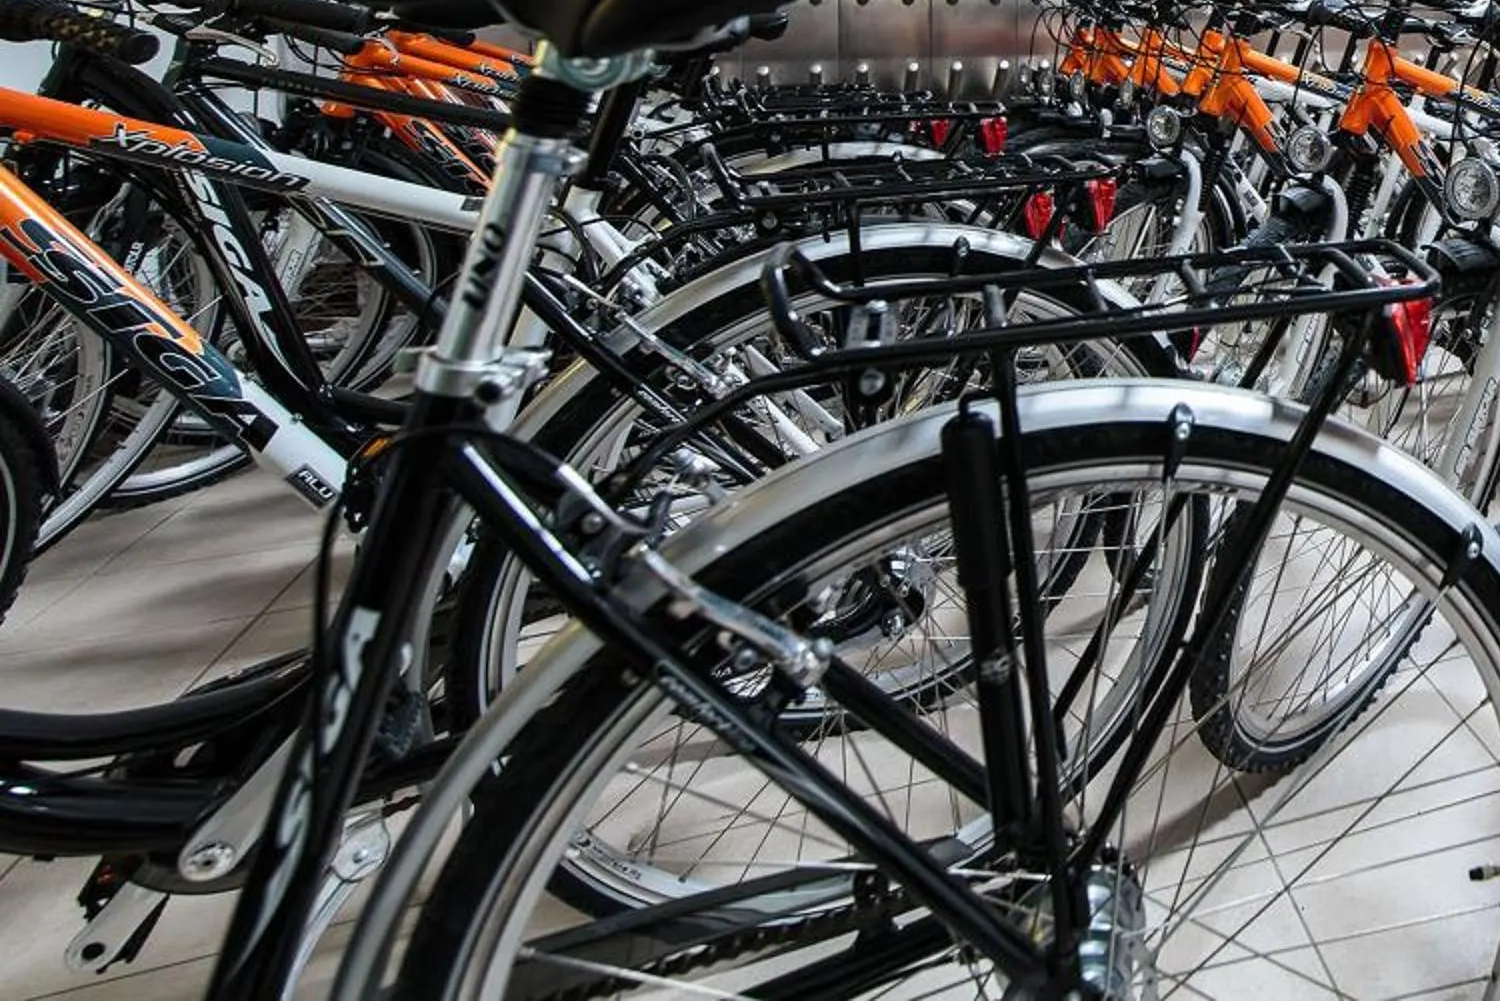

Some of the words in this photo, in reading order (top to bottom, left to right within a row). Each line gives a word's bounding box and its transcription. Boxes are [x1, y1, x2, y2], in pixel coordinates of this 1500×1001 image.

[101, 122, 311, 187] Xplosion
[28, 247, 280, 453] SIGA
[299, 470, 333, 498] ALU
